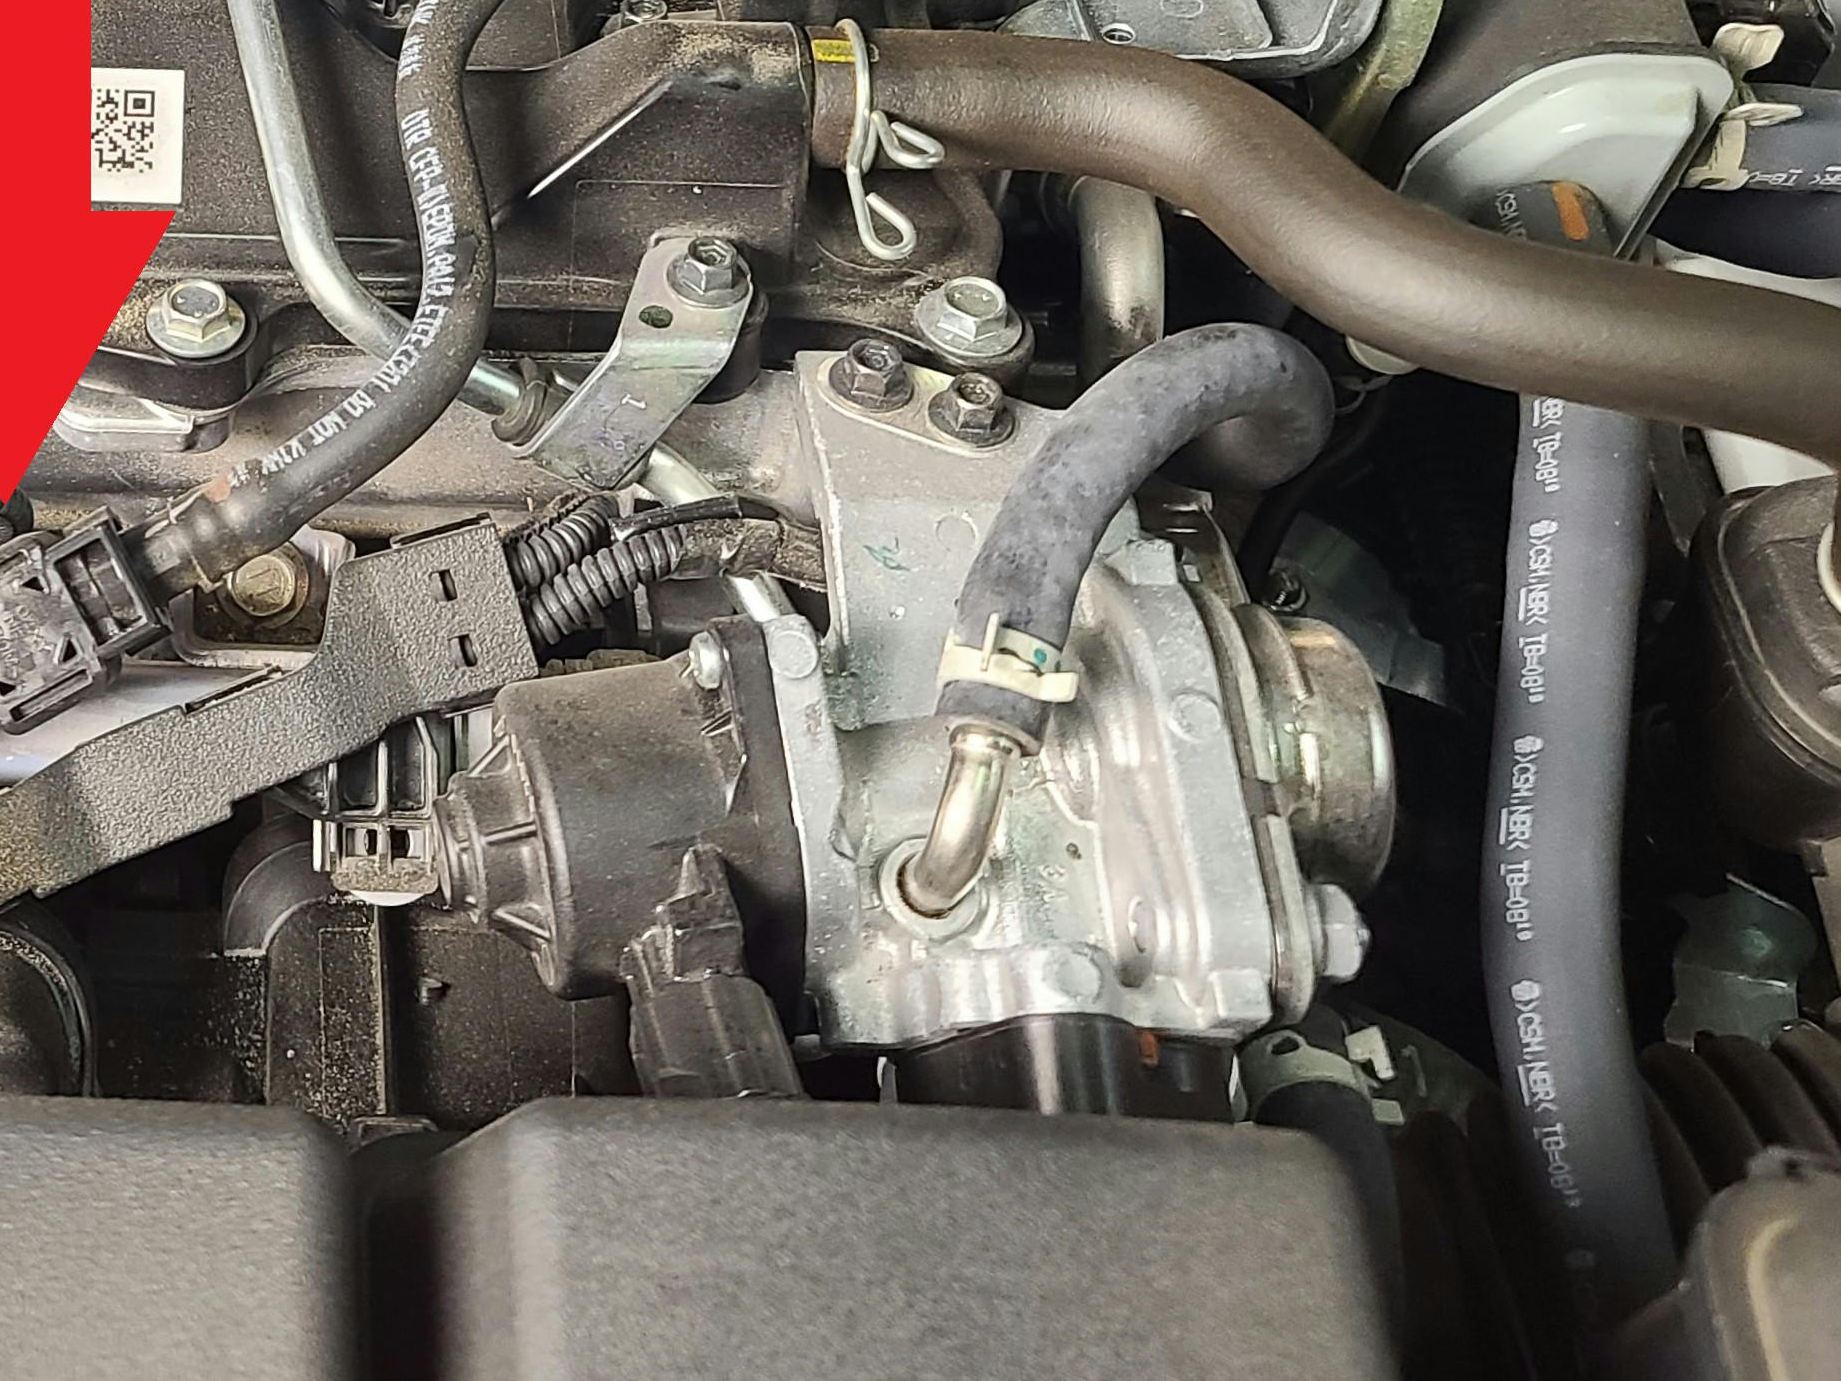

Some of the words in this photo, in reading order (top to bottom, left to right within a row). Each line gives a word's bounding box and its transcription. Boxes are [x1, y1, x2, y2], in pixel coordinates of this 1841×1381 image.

[342, 387, 376, 420] DO
[305, 412, 349, 449] NOT
[261, 438, 308, 477] KINK
